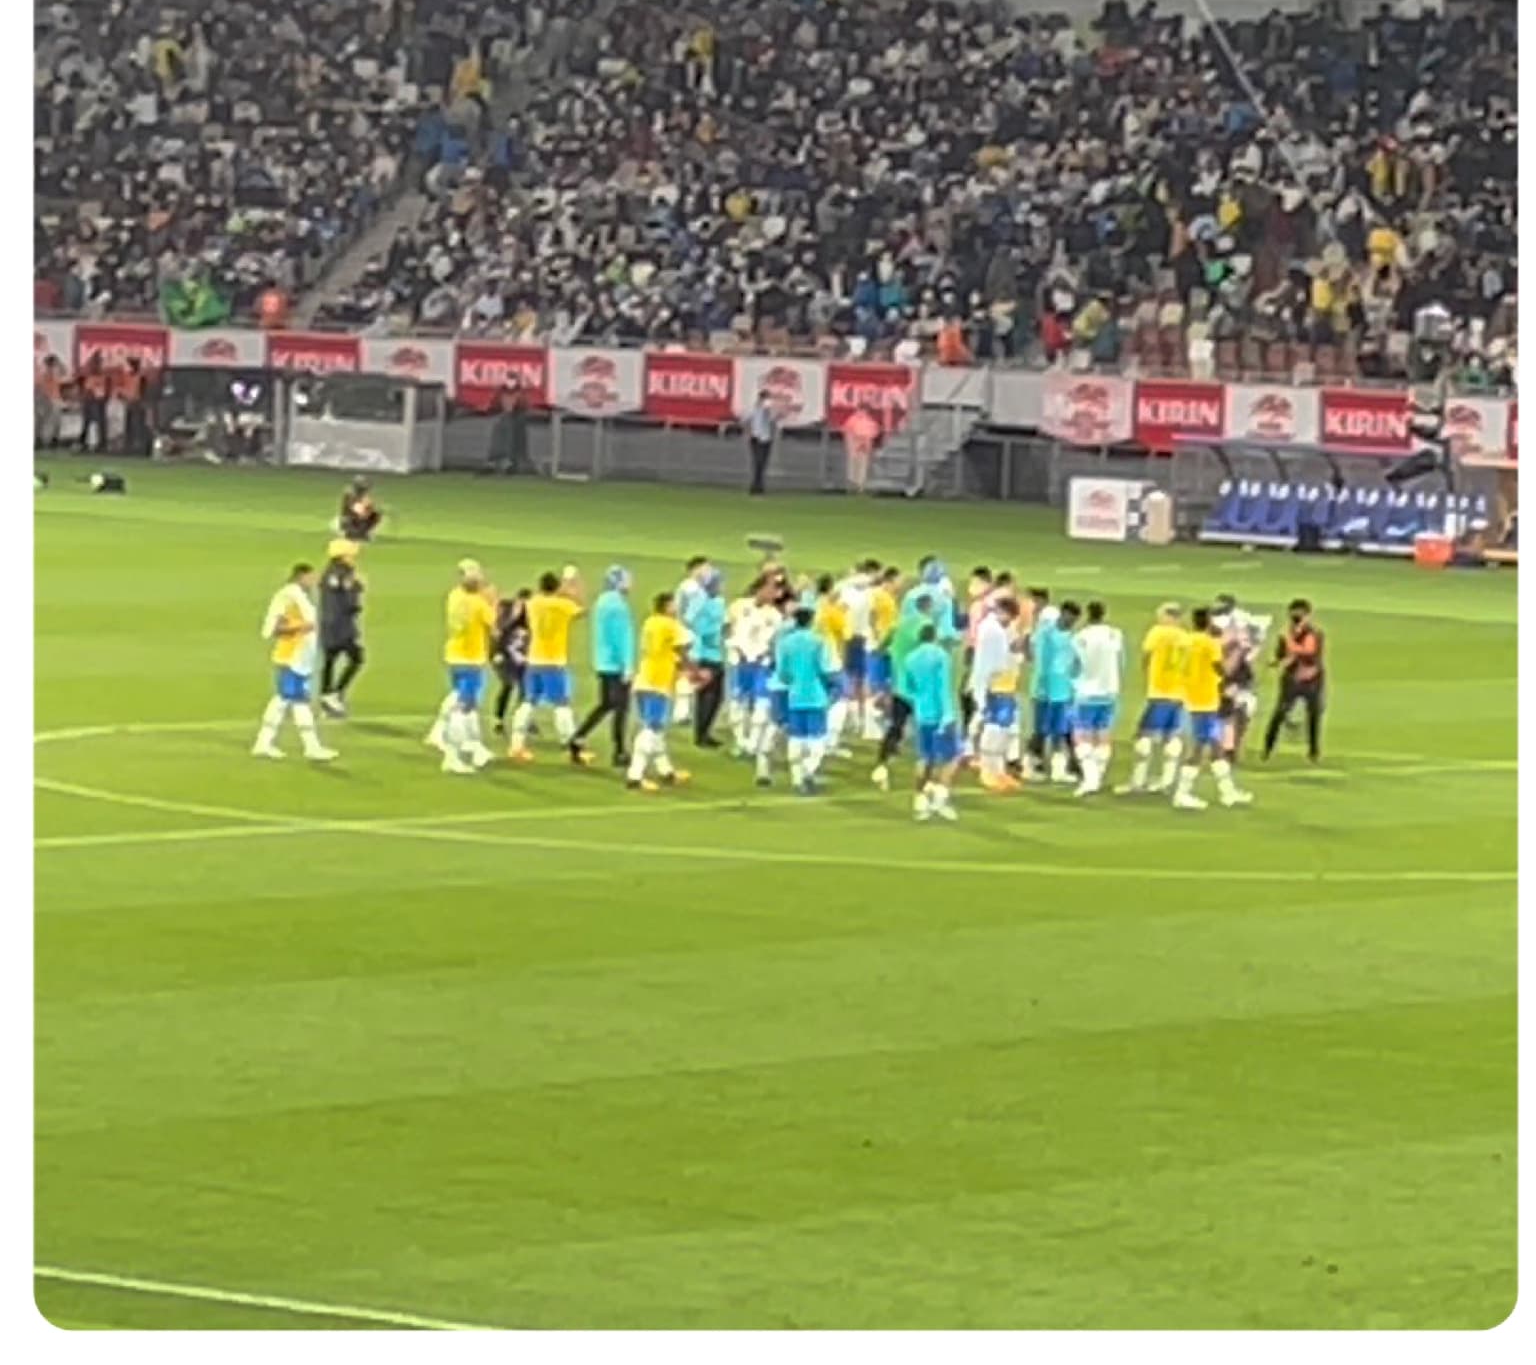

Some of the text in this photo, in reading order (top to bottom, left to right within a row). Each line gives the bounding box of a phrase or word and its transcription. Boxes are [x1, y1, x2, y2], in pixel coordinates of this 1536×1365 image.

[648, 369, 728, 400] KIRIN
[1137, 396, 1220, 426] KIRIN
[1325, 408, 1410, 438] KIRIN
